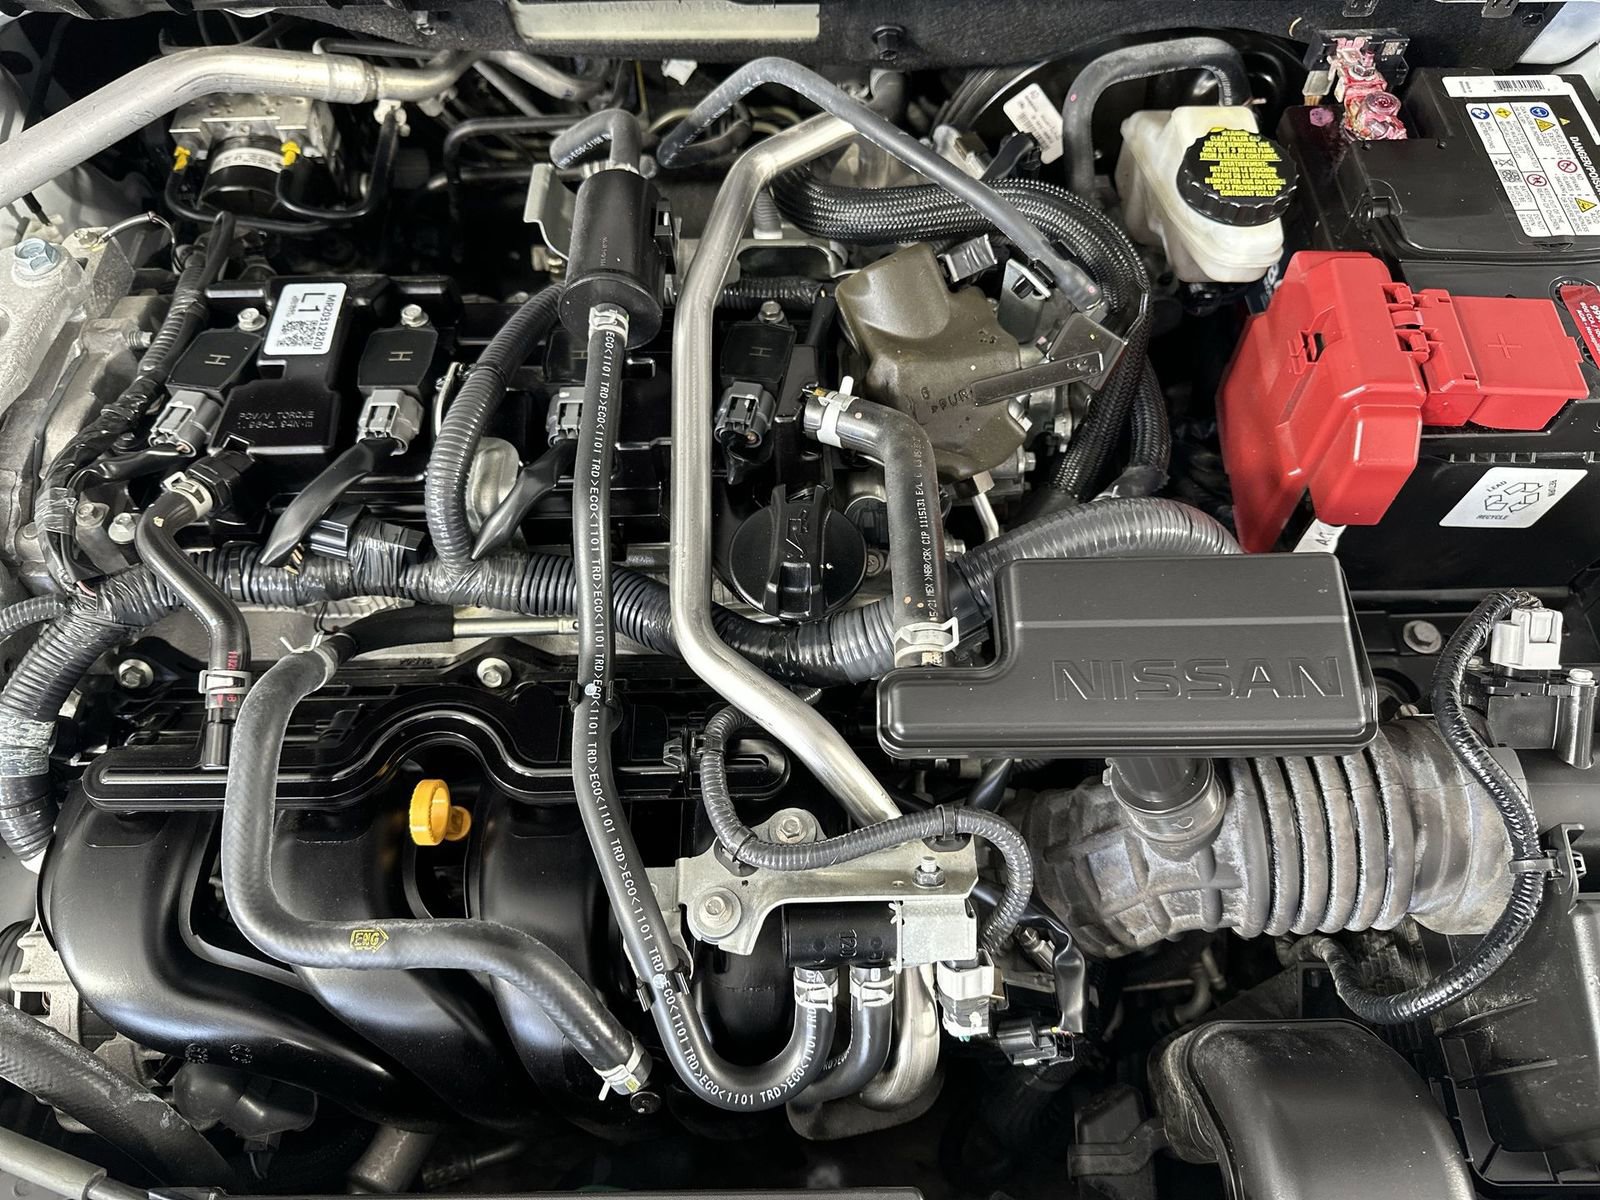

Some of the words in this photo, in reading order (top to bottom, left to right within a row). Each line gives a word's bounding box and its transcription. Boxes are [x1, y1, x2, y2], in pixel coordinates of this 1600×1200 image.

[1569, 136, 1600, 195] DANGER/POISO
[298, 292, 326, 312] L1
[593, 381, 610, 454] TRD>ECO<1101
[589, 458, 602, 552] TRD>ECO<1101
[1486, 480, 1508, 493] LEAD
[591, 558, 605, 649] TRD>ECO<1101
[1052, 657, 1344, 701] NISSAN
[587, 742, 615, 833] TRD>ECO<1101
[610, 837, 654, 942] TRD>ECO<1101
[354, 932, 380, 947] ENG
[682, 1045, 755, 1106] TRD>ECO<1101
